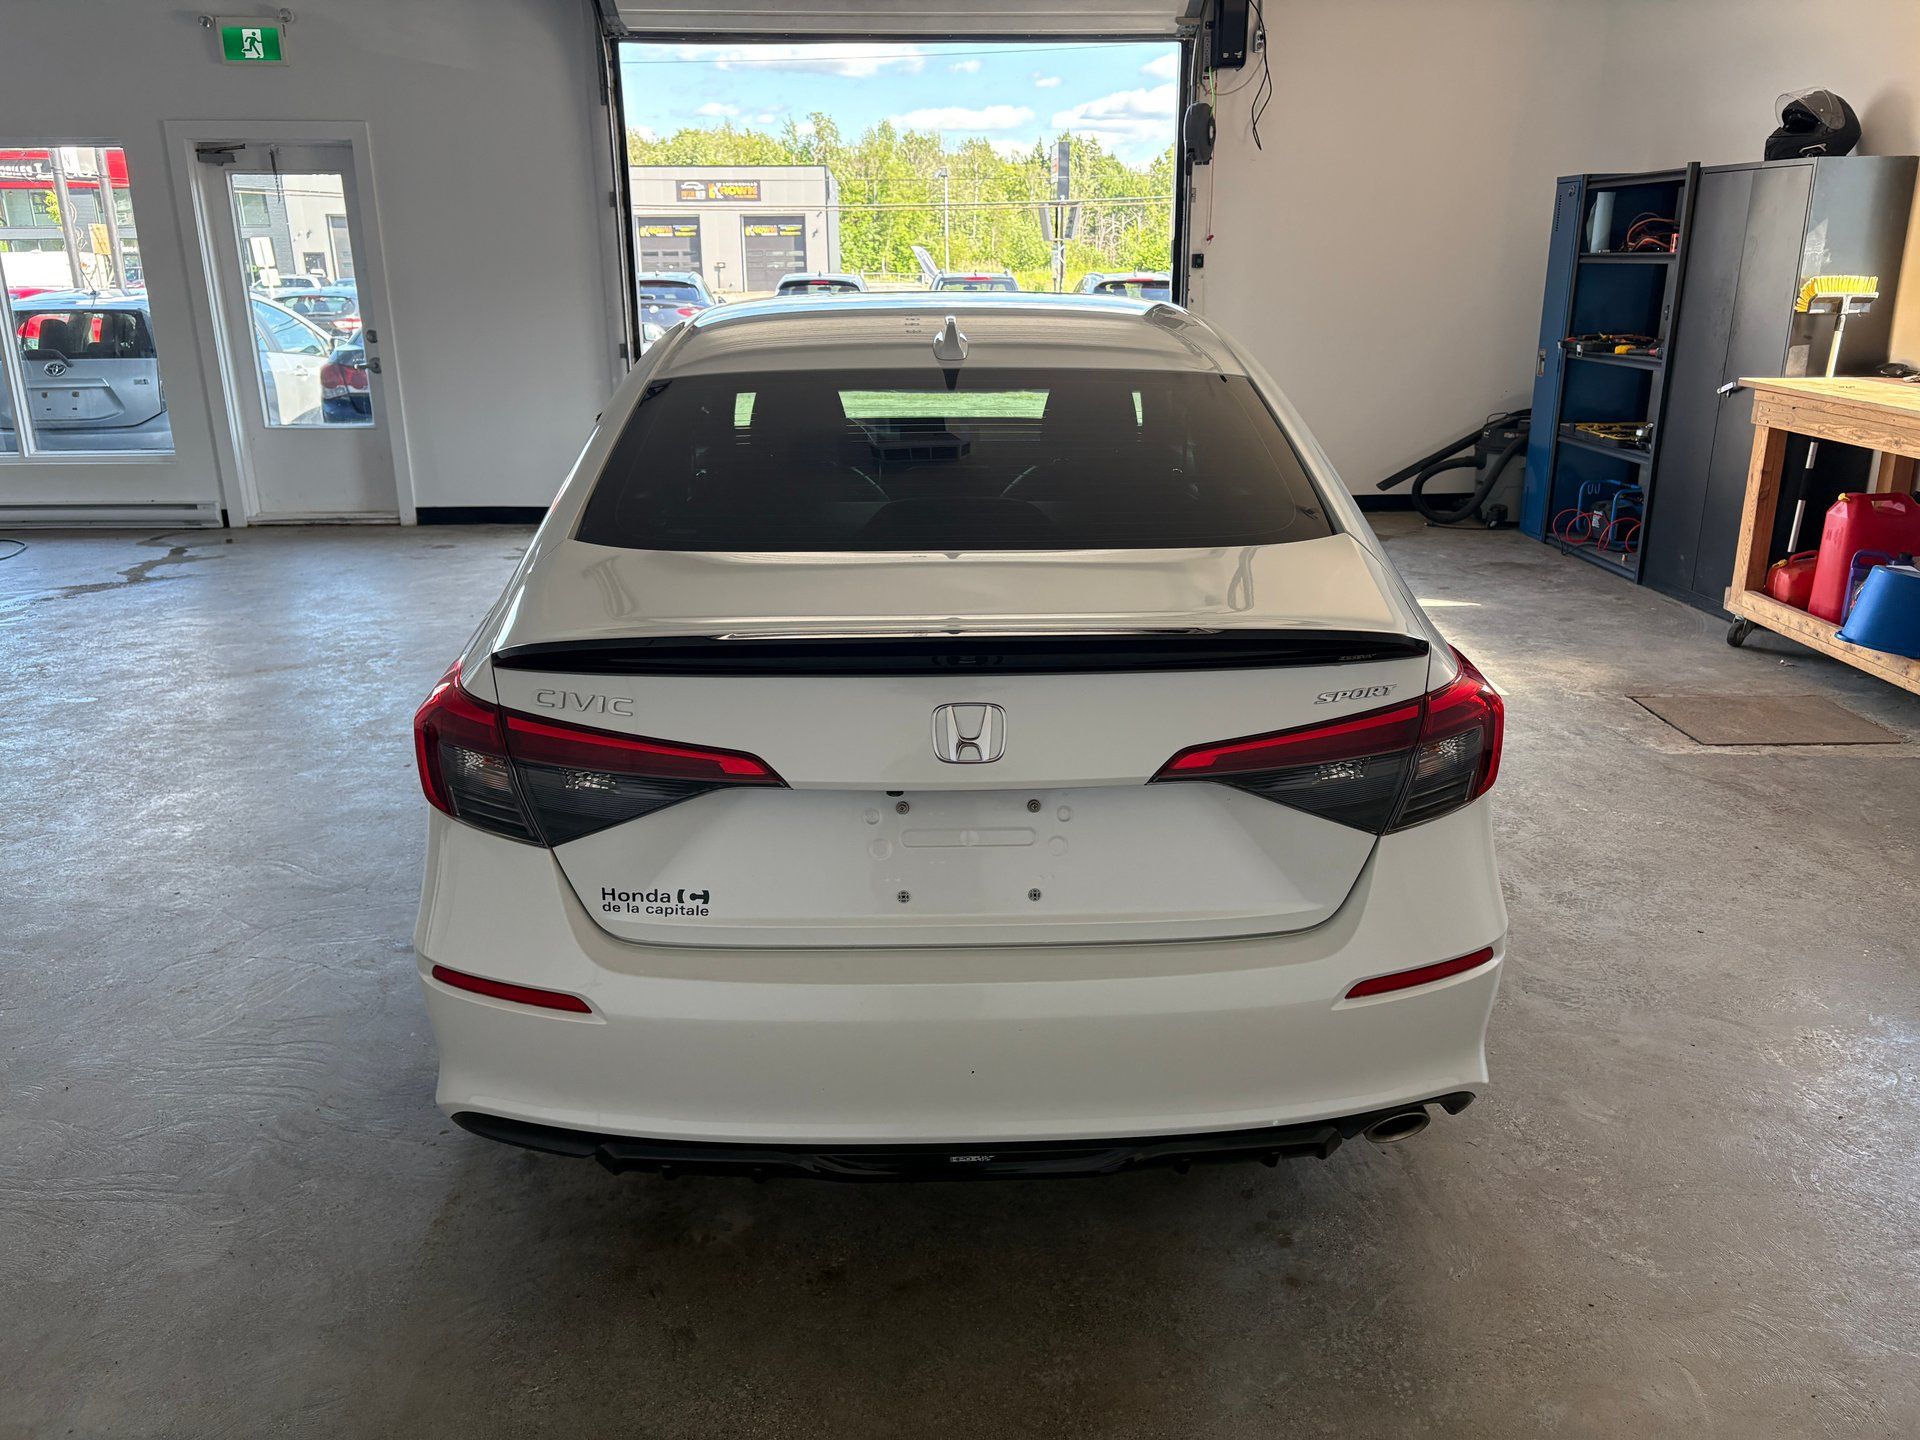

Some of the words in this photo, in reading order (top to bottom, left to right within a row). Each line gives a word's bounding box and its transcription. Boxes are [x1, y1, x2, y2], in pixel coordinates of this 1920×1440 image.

[536, 689, 634, 716] CIVIC
[1314, 684, 1397, 704] SPORT
[601, 887, 671, 903] Honda
[602, 902, 621, 912] de
[626, 902, 640, 913] la
[645, 904, 709, 917] capitale
